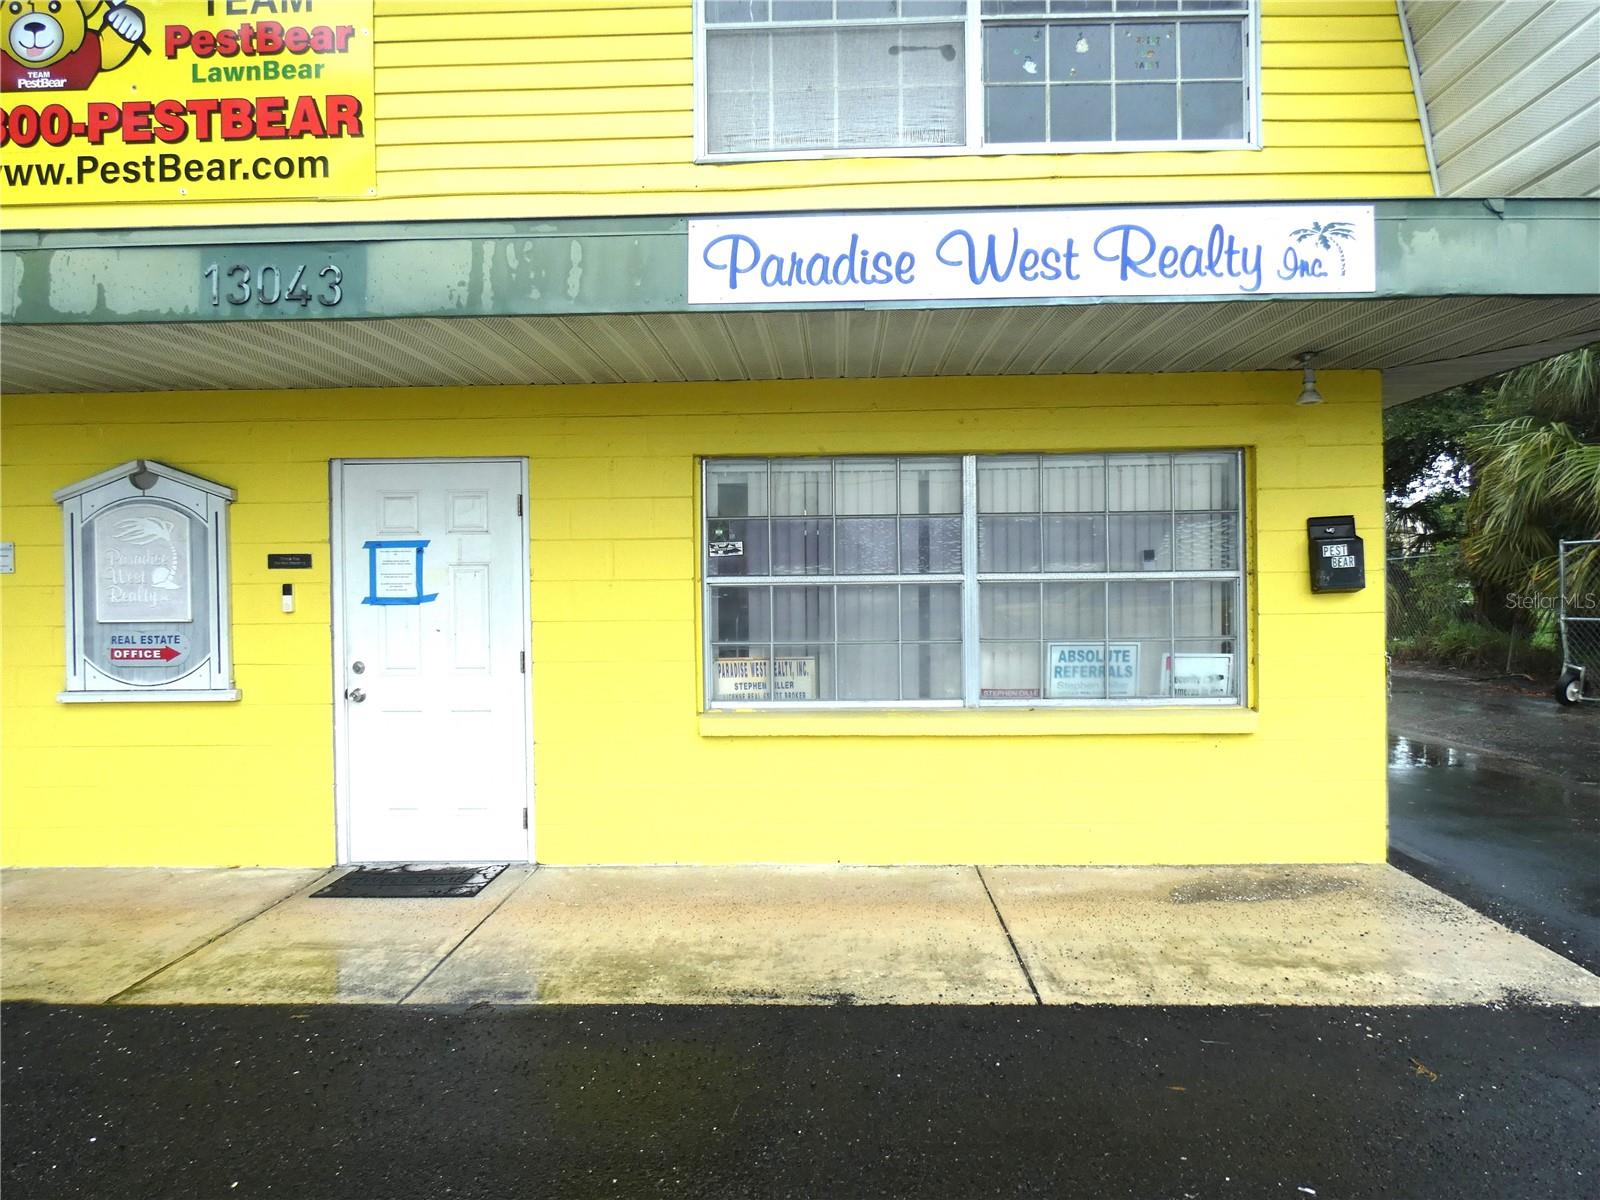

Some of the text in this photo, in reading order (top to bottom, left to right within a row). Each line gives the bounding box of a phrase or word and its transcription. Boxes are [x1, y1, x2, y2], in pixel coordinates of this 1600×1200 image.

[164, 20, 355, 60] PestBear
[191, 60, 325, 83] LawnBear
[17, 78, 68, 89] PestBear
[0, 153, 330, 187] ww.PestBear.com
[702, 233, 916, 290] Paradise
[935, 227, 1080, 285] West
[1093, 223, 1263, 292] Realty
[204, 263, 343, 307] 13043
[1323, 545, 1347, 556] PEST
[1332, 557, 1354, 568] BEAR
[111, 635, 180, 645] REAL ESTATE
[113, 649, 161, 659] OFFICE
[1058, 649, 1131, 663] ABSOLUTE
[718, 661, 809, 680] PARADISE WEST EALTY, INC.
[1054, 665, 1133, 679] REFERRALS
[734, 681, 794, 690] STEPHEN ILLER
